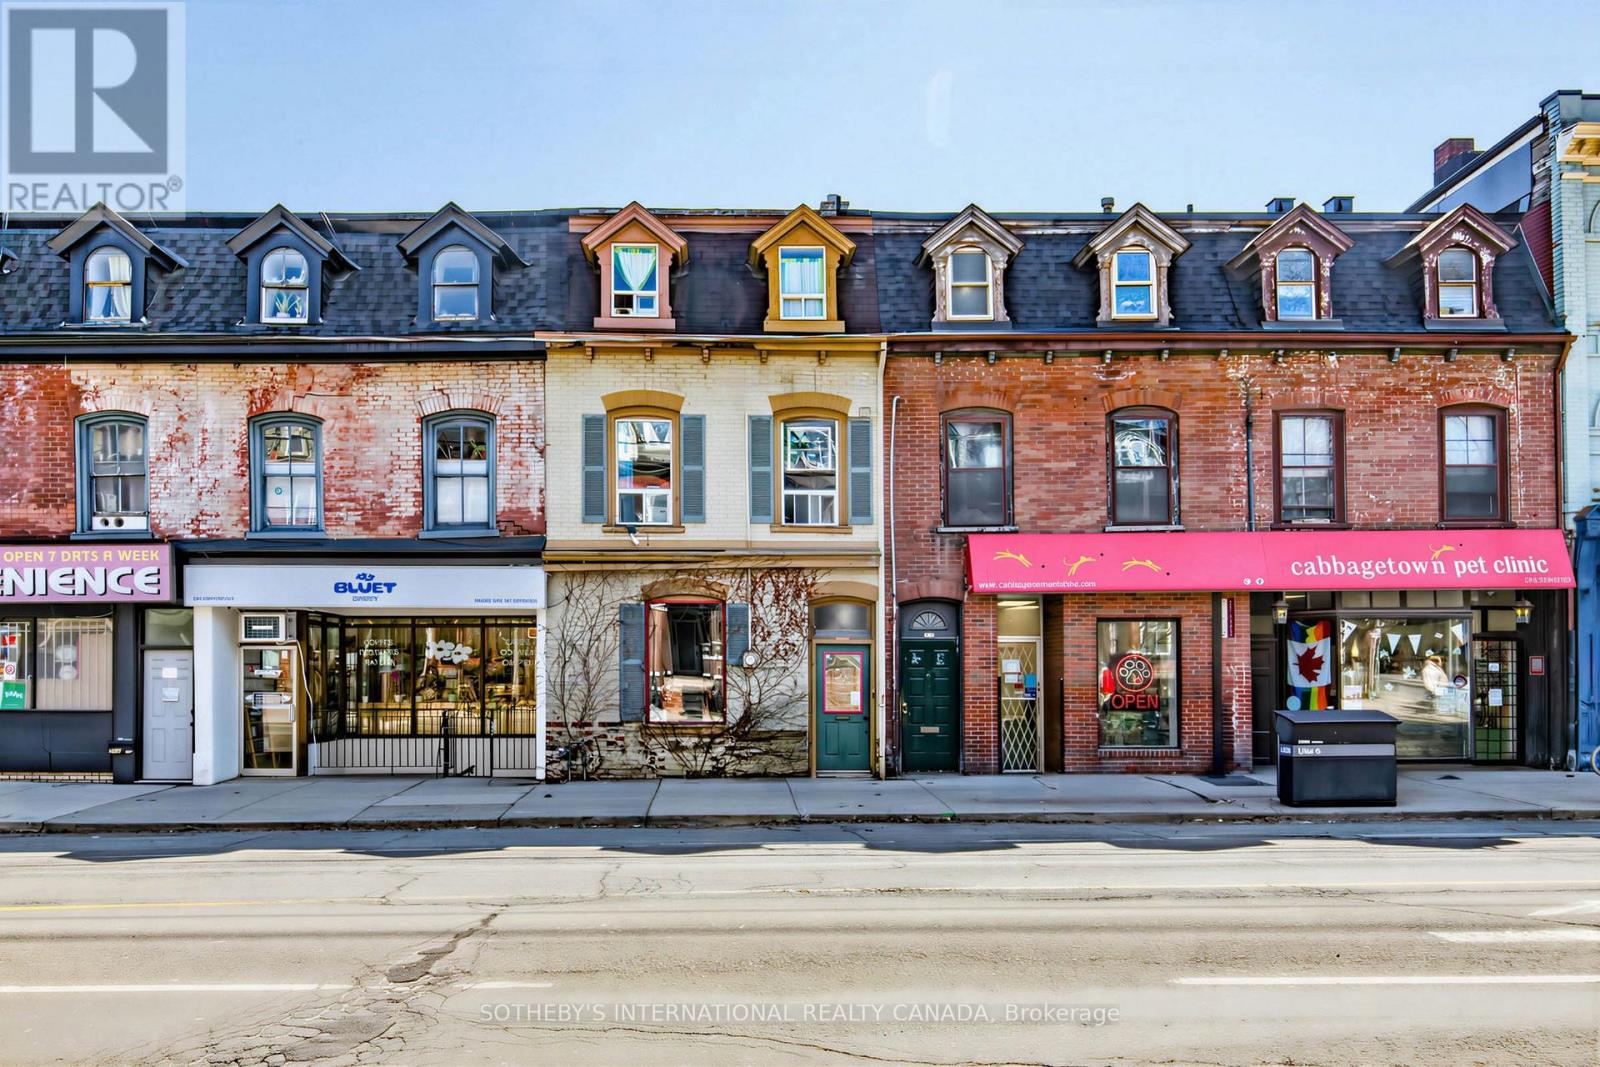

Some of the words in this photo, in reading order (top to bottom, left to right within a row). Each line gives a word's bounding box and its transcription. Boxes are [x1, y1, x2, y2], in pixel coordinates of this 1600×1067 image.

[4, 551, 44, 562] OPEN
[48, 550, 56, 562] 7
[118, 549, 159, 561] WEEK
[1291, 555, 1446, 579] cabbagetown
[1454, 556, 1487, 577] pet
[1493, 556, 1549, 573] clinic
[0, 566, 160, 596] NIENCE
[334, 582, 397, 594] BLUET
[1112, 694, 1159, 709] OPEN
